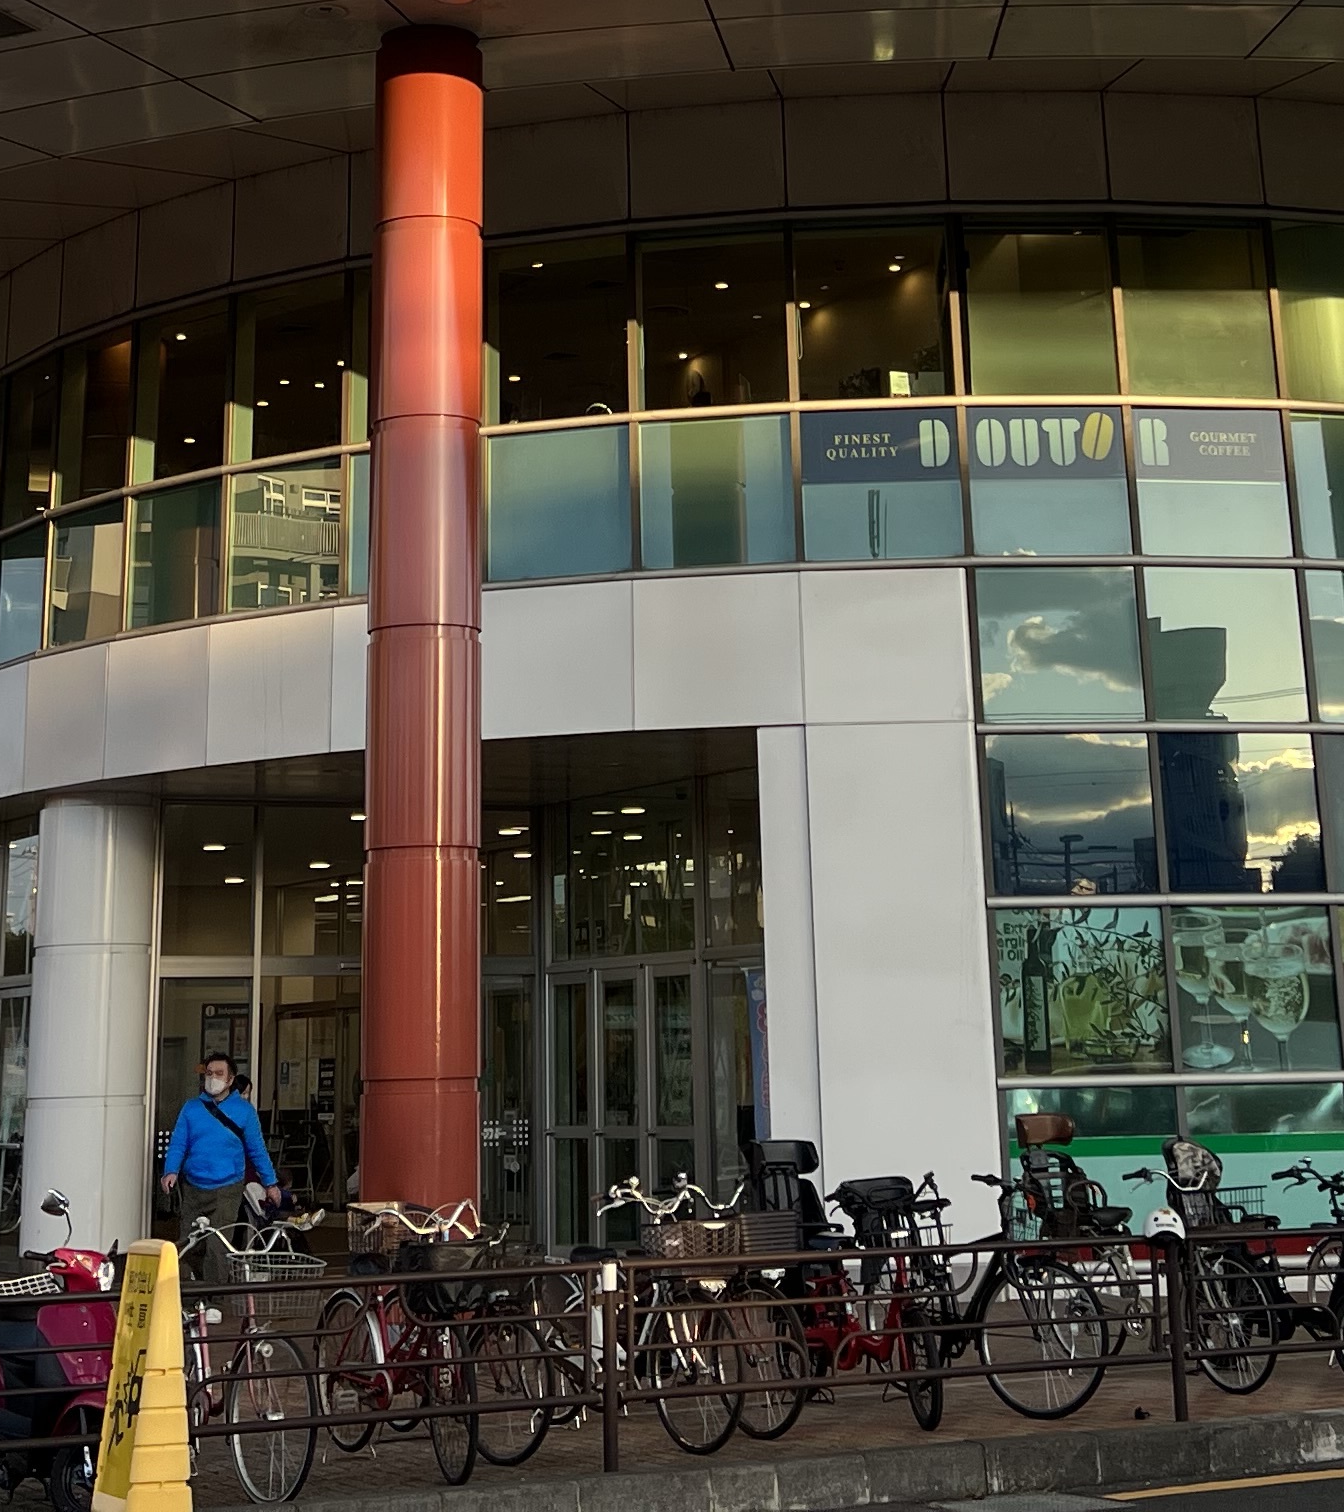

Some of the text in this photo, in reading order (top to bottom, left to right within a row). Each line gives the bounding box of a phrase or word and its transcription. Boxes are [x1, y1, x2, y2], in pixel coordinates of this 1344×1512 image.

[834, 433, 891, 445] FINEST
[919, 412, 1170, 468] DOUTOR
[1189, 431, 1257, 443] GOURMET
[825, 446, 899, 461] QUALITY
[1199, 444, 1251, 457] COFFEE
